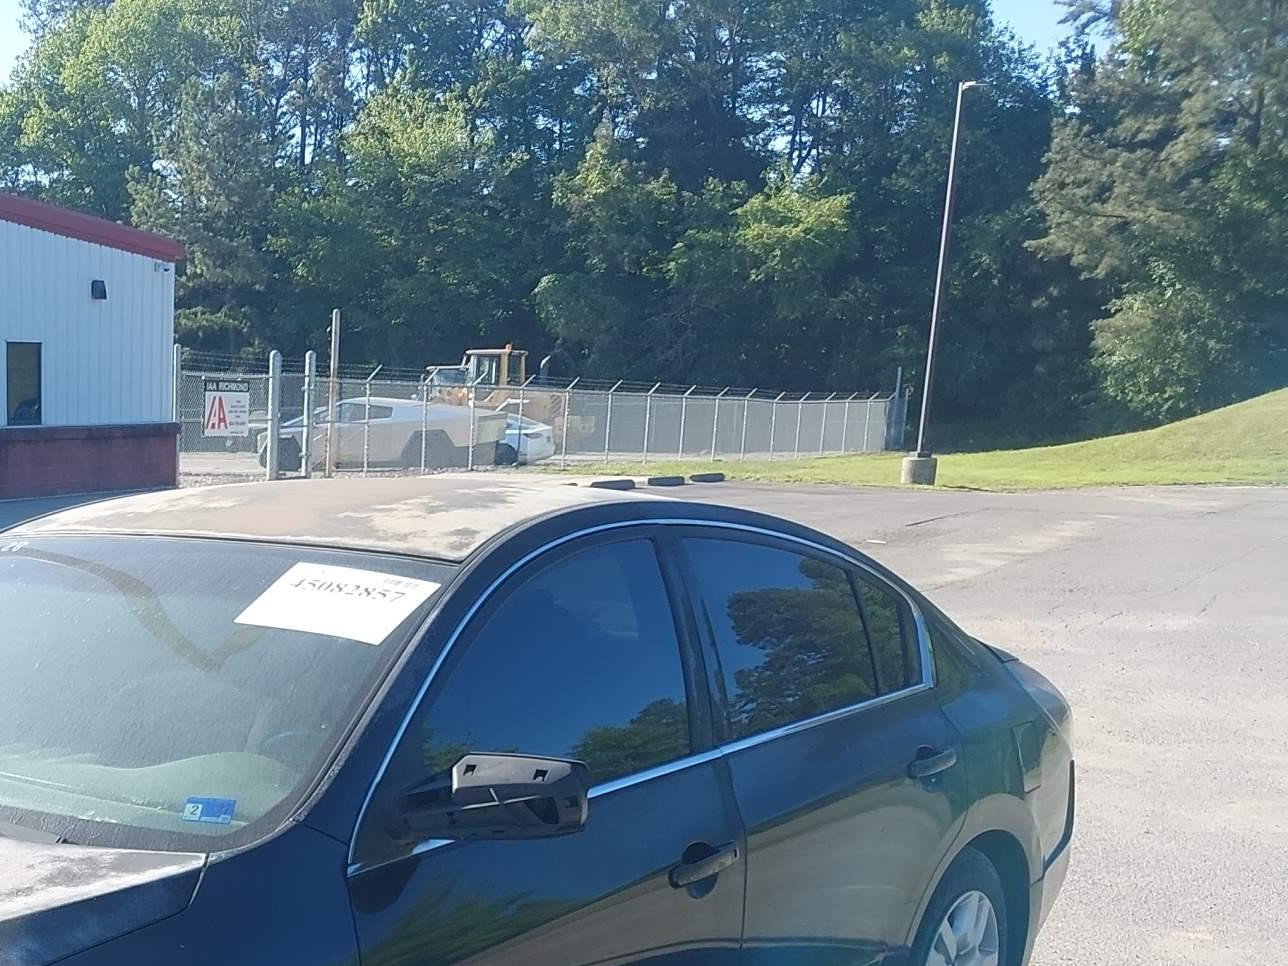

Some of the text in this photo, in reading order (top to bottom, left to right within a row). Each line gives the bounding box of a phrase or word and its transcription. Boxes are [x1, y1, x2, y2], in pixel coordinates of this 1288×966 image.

[206, 382, 249, 391] IAA RICHMOND
[290, 578, 407, 602] 45082857
[190, 805, 199, 815] 2
